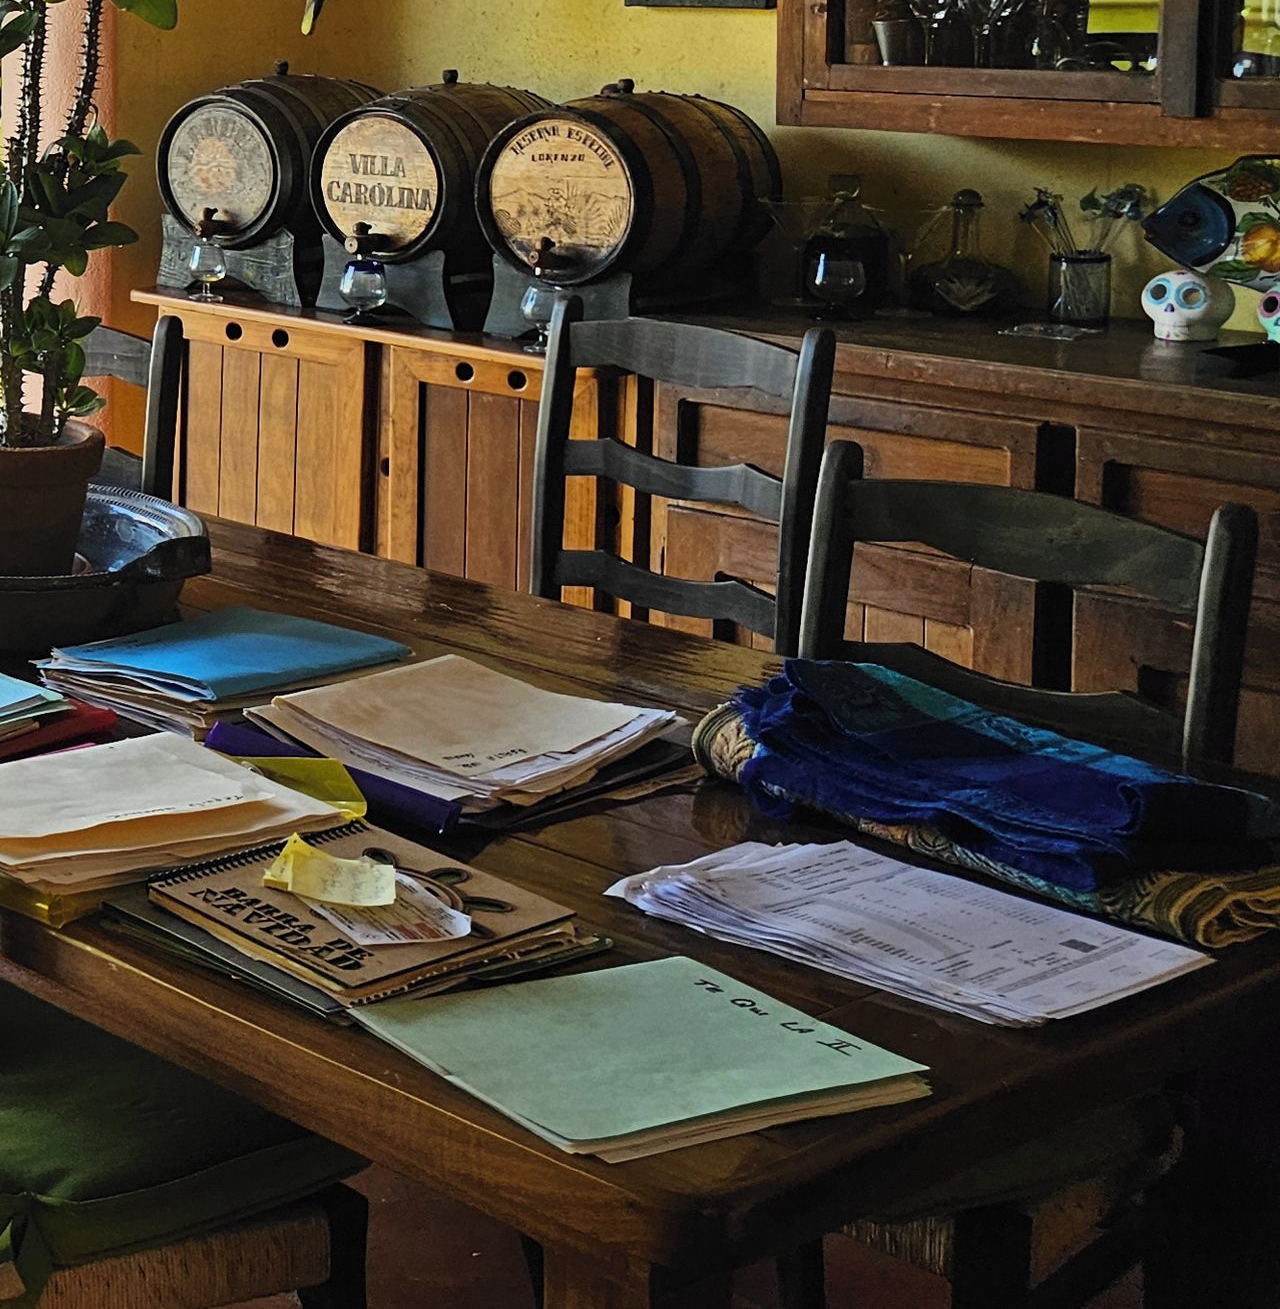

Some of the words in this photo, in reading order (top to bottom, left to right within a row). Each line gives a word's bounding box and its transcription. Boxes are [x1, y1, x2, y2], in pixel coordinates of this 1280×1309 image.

[349, 153, 406, 178] VILLA
[531, 153, 585, 164] LORENZO
[326, 180, 433, 211] CAROLINA
[188, 888, 366, 971] NAVIDAD
[220, 887, 317, 935] BARRA
[324, 937, 375, 960] DE
